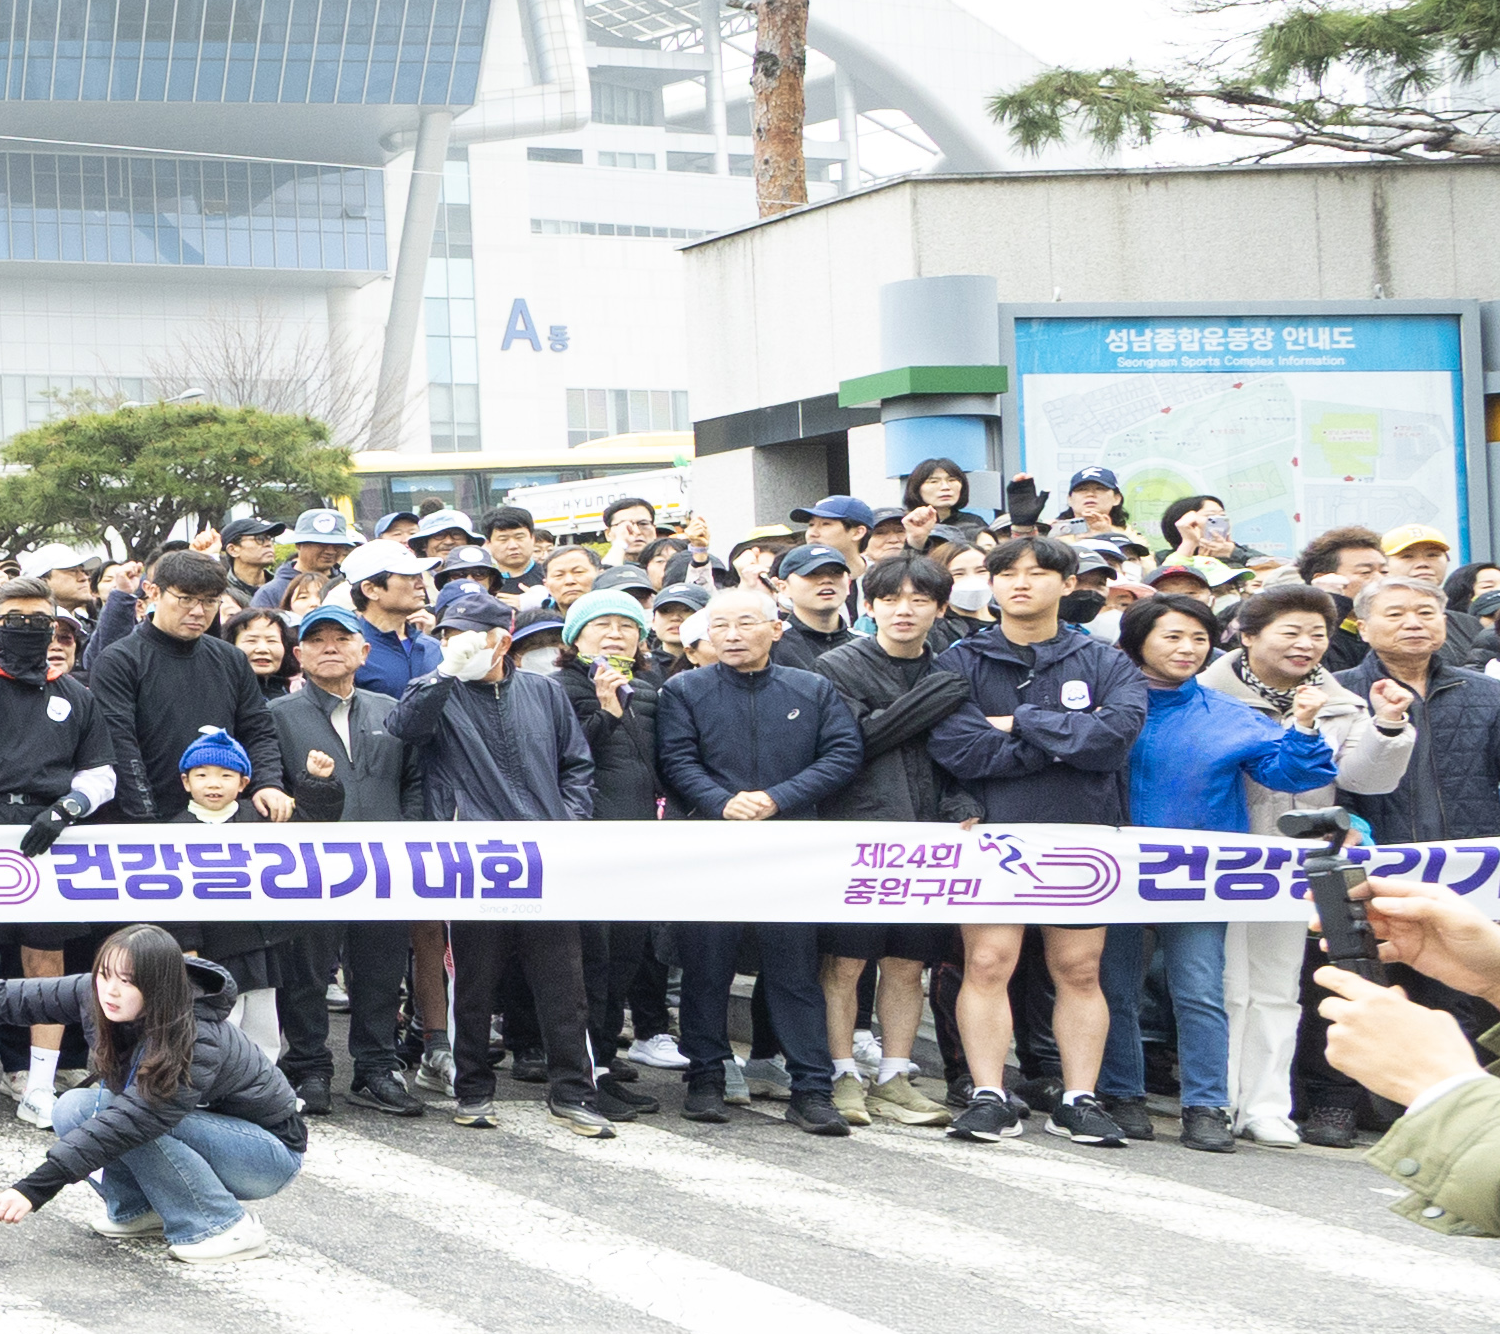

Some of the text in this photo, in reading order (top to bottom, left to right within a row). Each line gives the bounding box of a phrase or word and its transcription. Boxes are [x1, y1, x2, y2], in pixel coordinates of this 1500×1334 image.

[1104, 326, 1356, 353] 성남종합운동장 안내도
[1116, 355, 1345, 369] Seongnam Sports Complex Information
[562, 492, 630, 510] HYUND
[54, 839, 544, 900] 건강달리기 대회
[851, 843, 962, 871] 제24회
[843, 877, 981, 908] 중원구민
[510, 902, 543, 915] 2000
